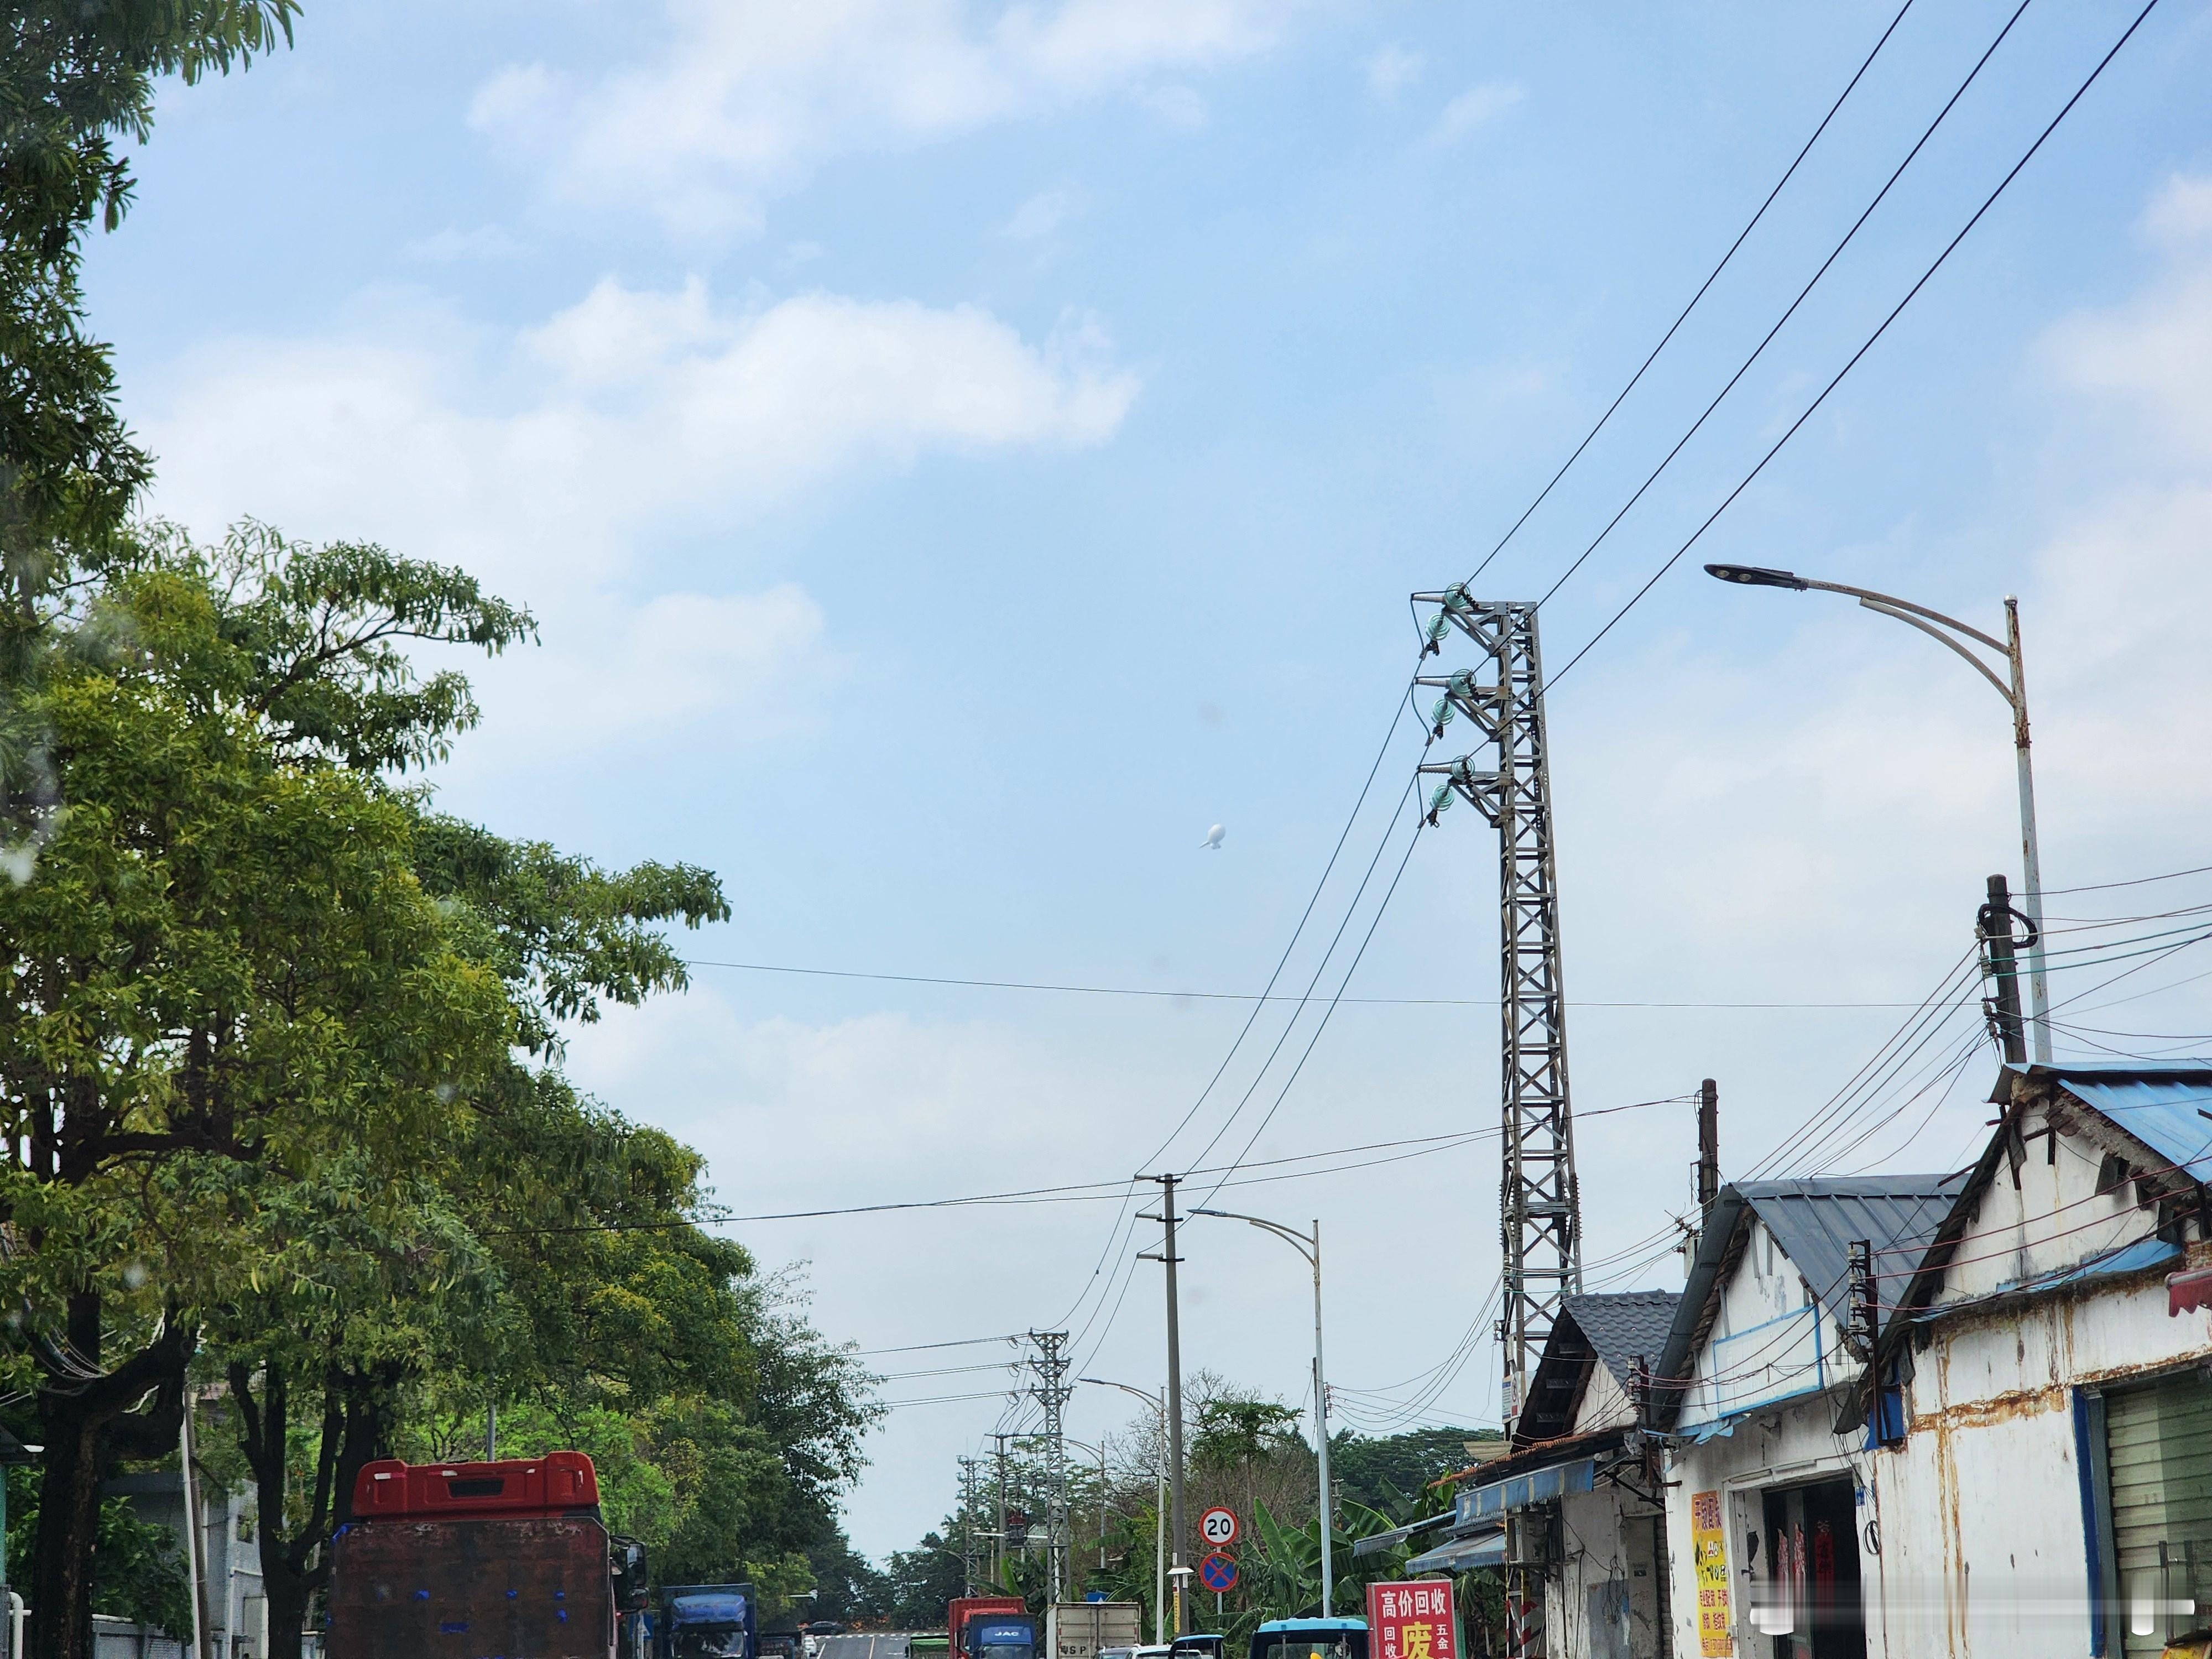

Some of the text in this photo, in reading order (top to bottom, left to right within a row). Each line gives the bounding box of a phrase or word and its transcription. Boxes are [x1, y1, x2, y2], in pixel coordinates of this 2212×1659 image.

[1207, 1518, 1230, 1536] 20
[1381, 1588, 1446, 1618] 高价回收
[1384, 1626, 1396, 1658] 回收
[1402, 1621, 1433, 1659] 废
